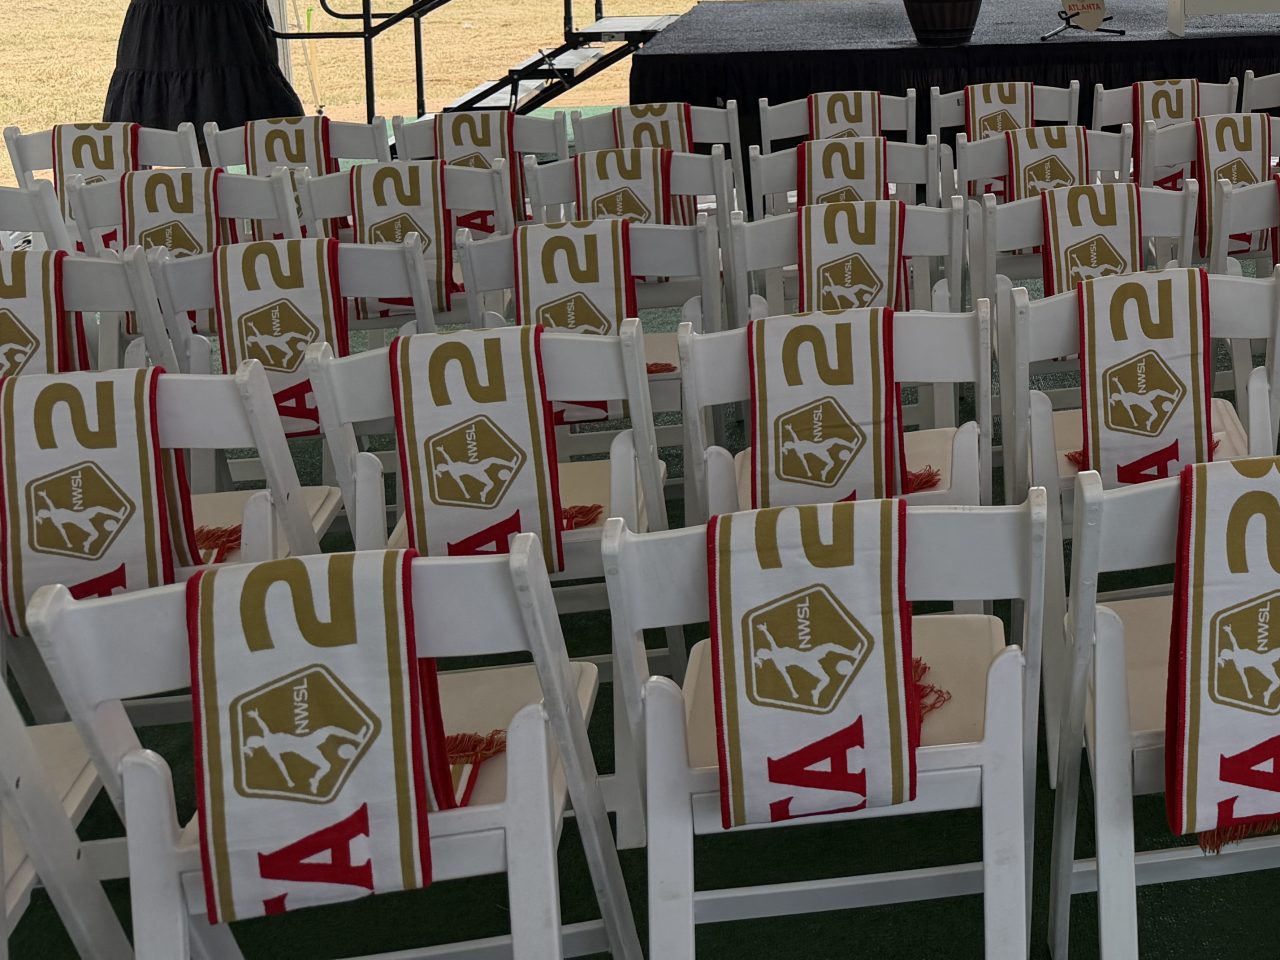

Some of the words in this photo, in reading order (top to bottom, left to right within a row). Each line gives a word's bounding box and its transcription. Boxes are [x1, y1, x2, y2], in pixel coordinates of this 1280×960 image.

[845, 259, 853, 286] NWSL
[272, 305, 281, 337] NWSL
[567, 299, 576, 328] NWSL
[1137, 357, 1146, 394] NWSL
[813, 404, 823, 442] NWSL
[466, 424, 478, 464] NWSL
[72, 470, 84, 510] NWSL
[797, 596, 811, 649] NWSL
[1258, 601, 1270, 652] NWSL
[294, 678, 310, 734] NWSL
